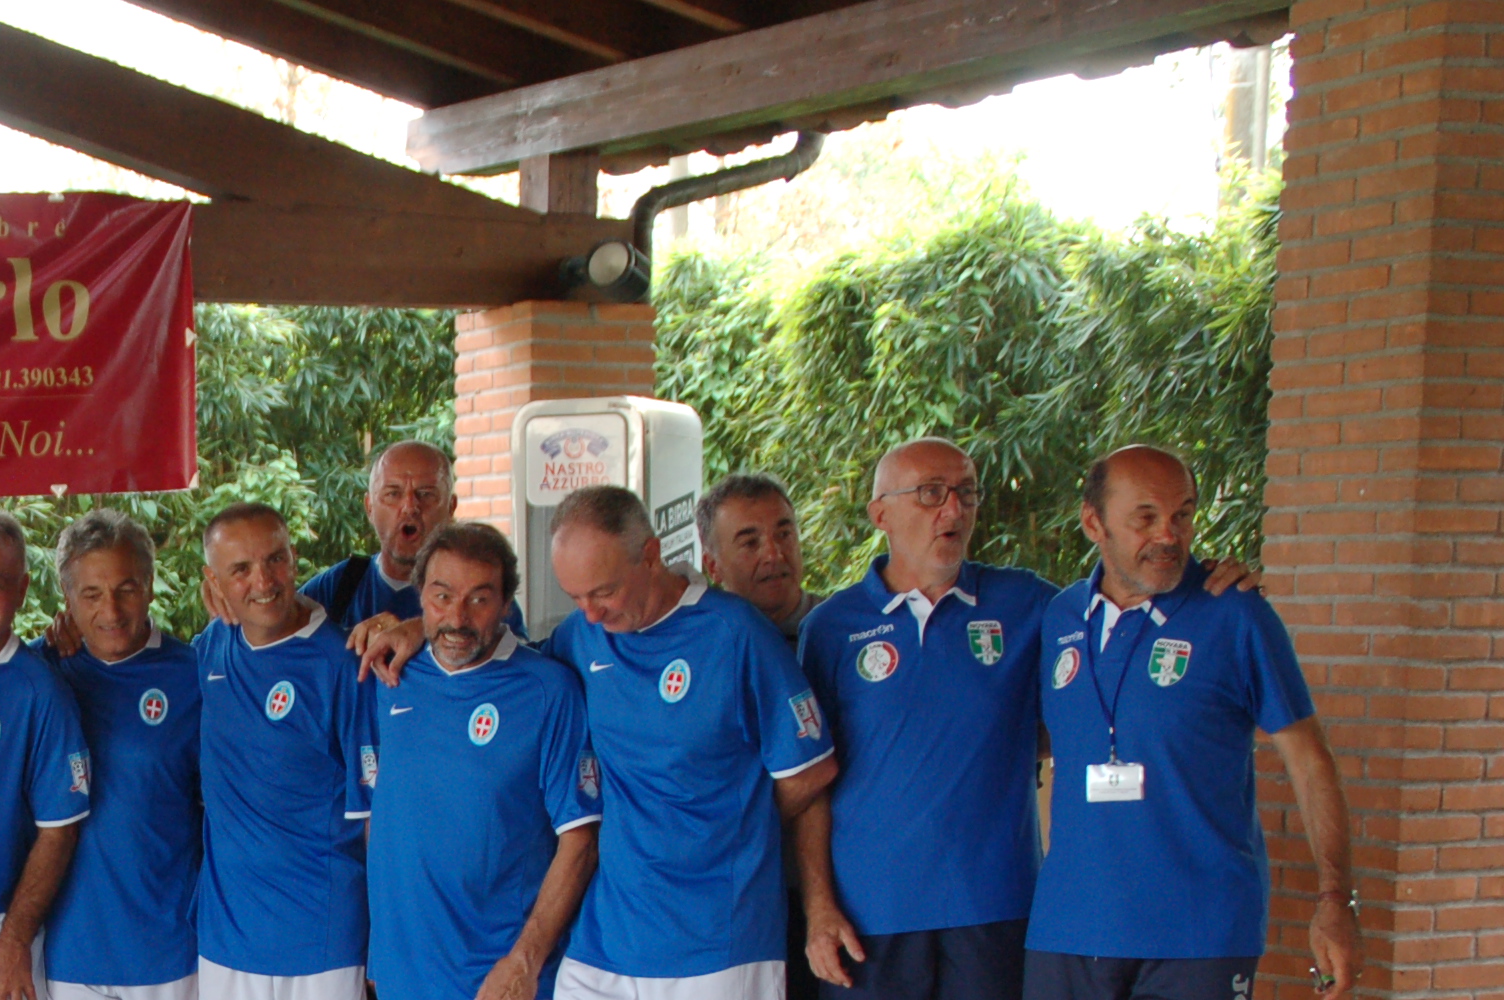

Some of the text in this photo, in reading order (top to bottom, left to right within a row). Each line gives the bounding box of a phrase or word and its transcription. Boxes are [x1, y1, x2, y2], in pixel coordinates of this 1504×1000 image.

[544, 461, 606, 476] NASTRO
[654, 506, 669, 537] LA
[848, 622, 895, 643] macron
